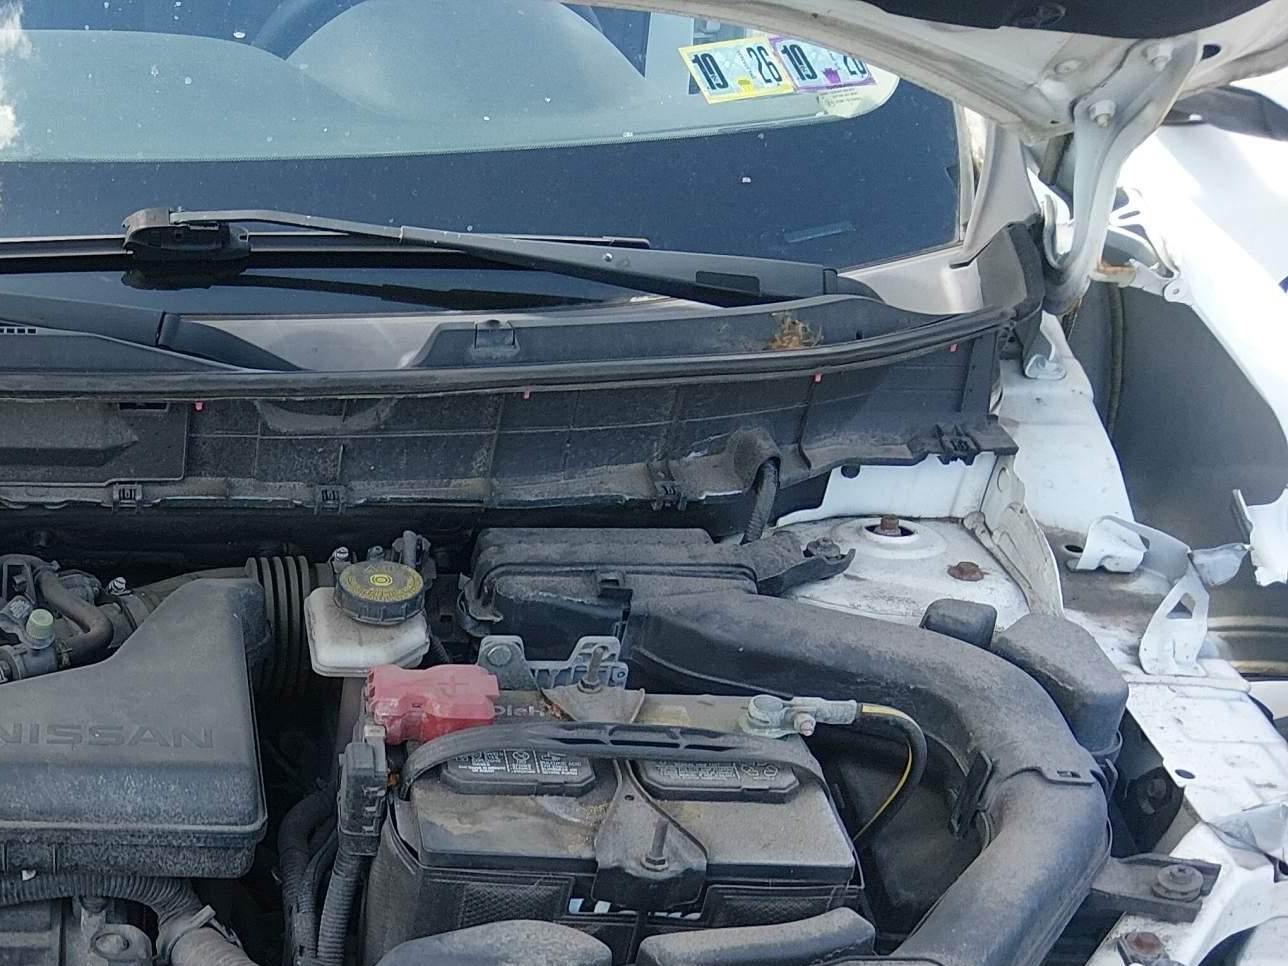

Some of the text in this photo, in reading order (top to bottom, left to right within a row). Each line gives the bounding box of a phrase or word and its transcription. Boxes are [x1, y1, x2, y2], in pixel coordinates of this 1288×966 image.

[691, 53, 729, 90] 10
[746, 45, 783, 84] 26
[780, 44, 817, 81] 10
